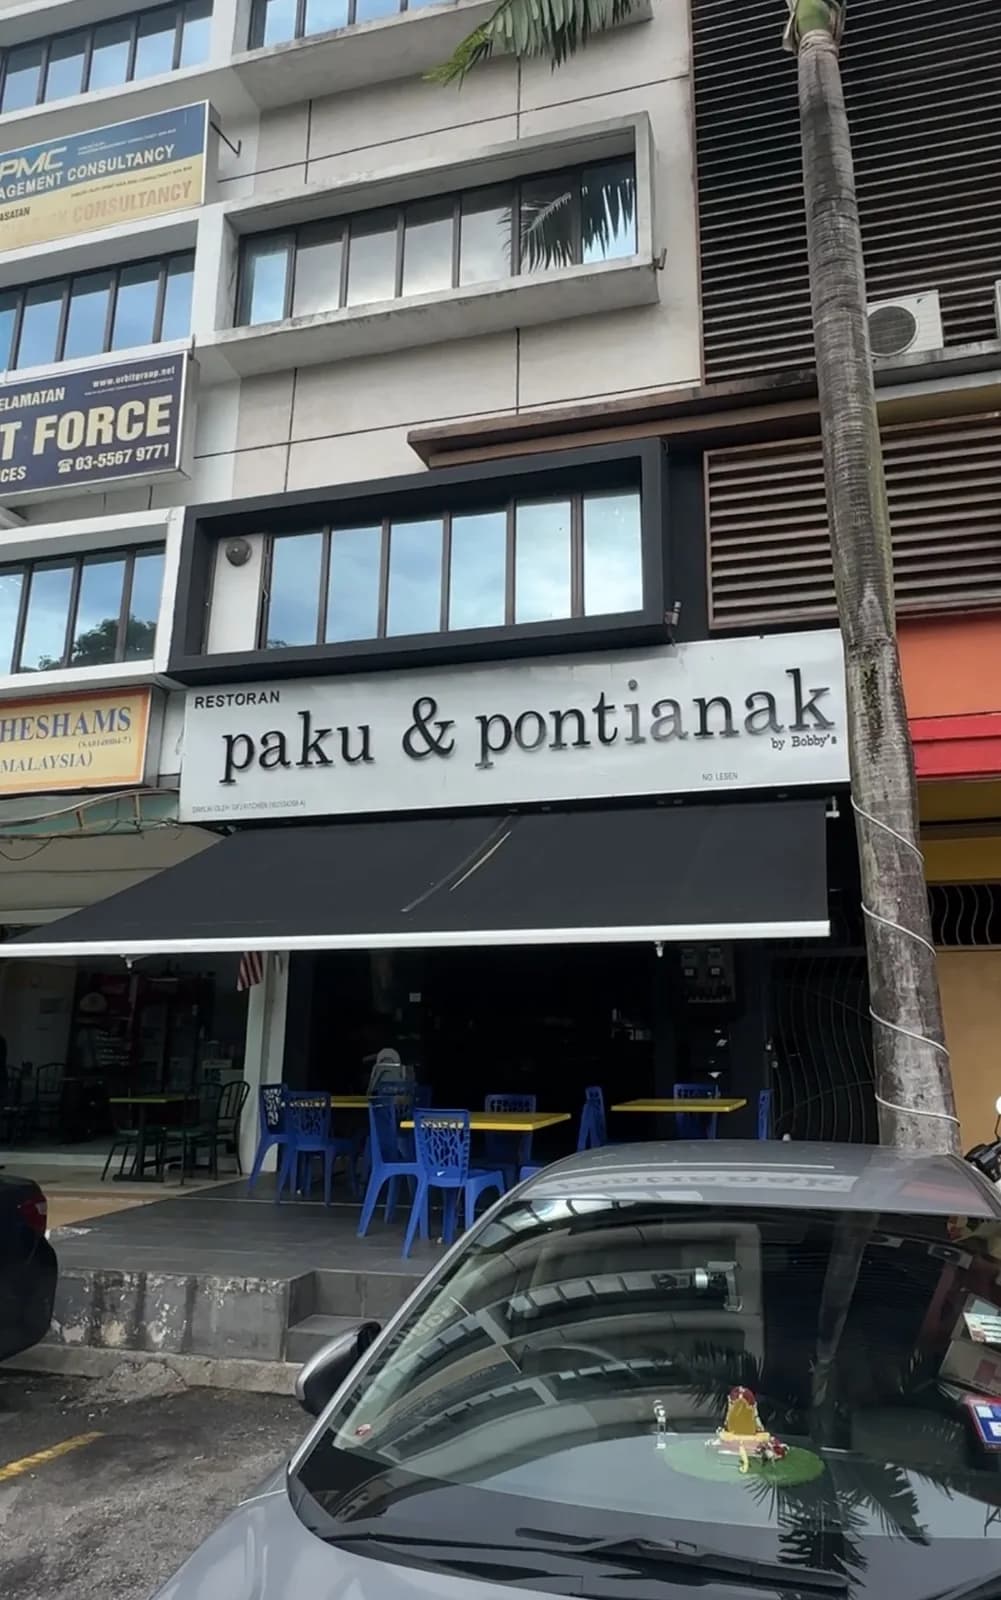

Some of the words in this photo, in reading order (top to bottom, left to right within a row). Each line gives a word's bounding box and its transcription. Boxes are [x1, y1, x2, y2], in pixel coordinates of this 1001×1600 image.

[68, 144, 175, 181] CONSULTANCY
[73, 181, 192, 224] CONSULTANCY
[0, 387, 65, 411] ELAMATAN
[0, 421, 22, 461] T
[32, 394, 173, 455] FORCE
[75, 449, 133, 471] 03-5567
[136, 443, 170, 461] 9771
[194, 690, 281, 709] RESTORAN
[0, 706, 131, 742] HESHAMS
[219, 710, 375, 784] paku
[402, 697, 455, 759] &
[475, 668, 835, 769] pontianak
[771, 738, 785, 750] by
[791, 734, 837, 748] Bobby's
